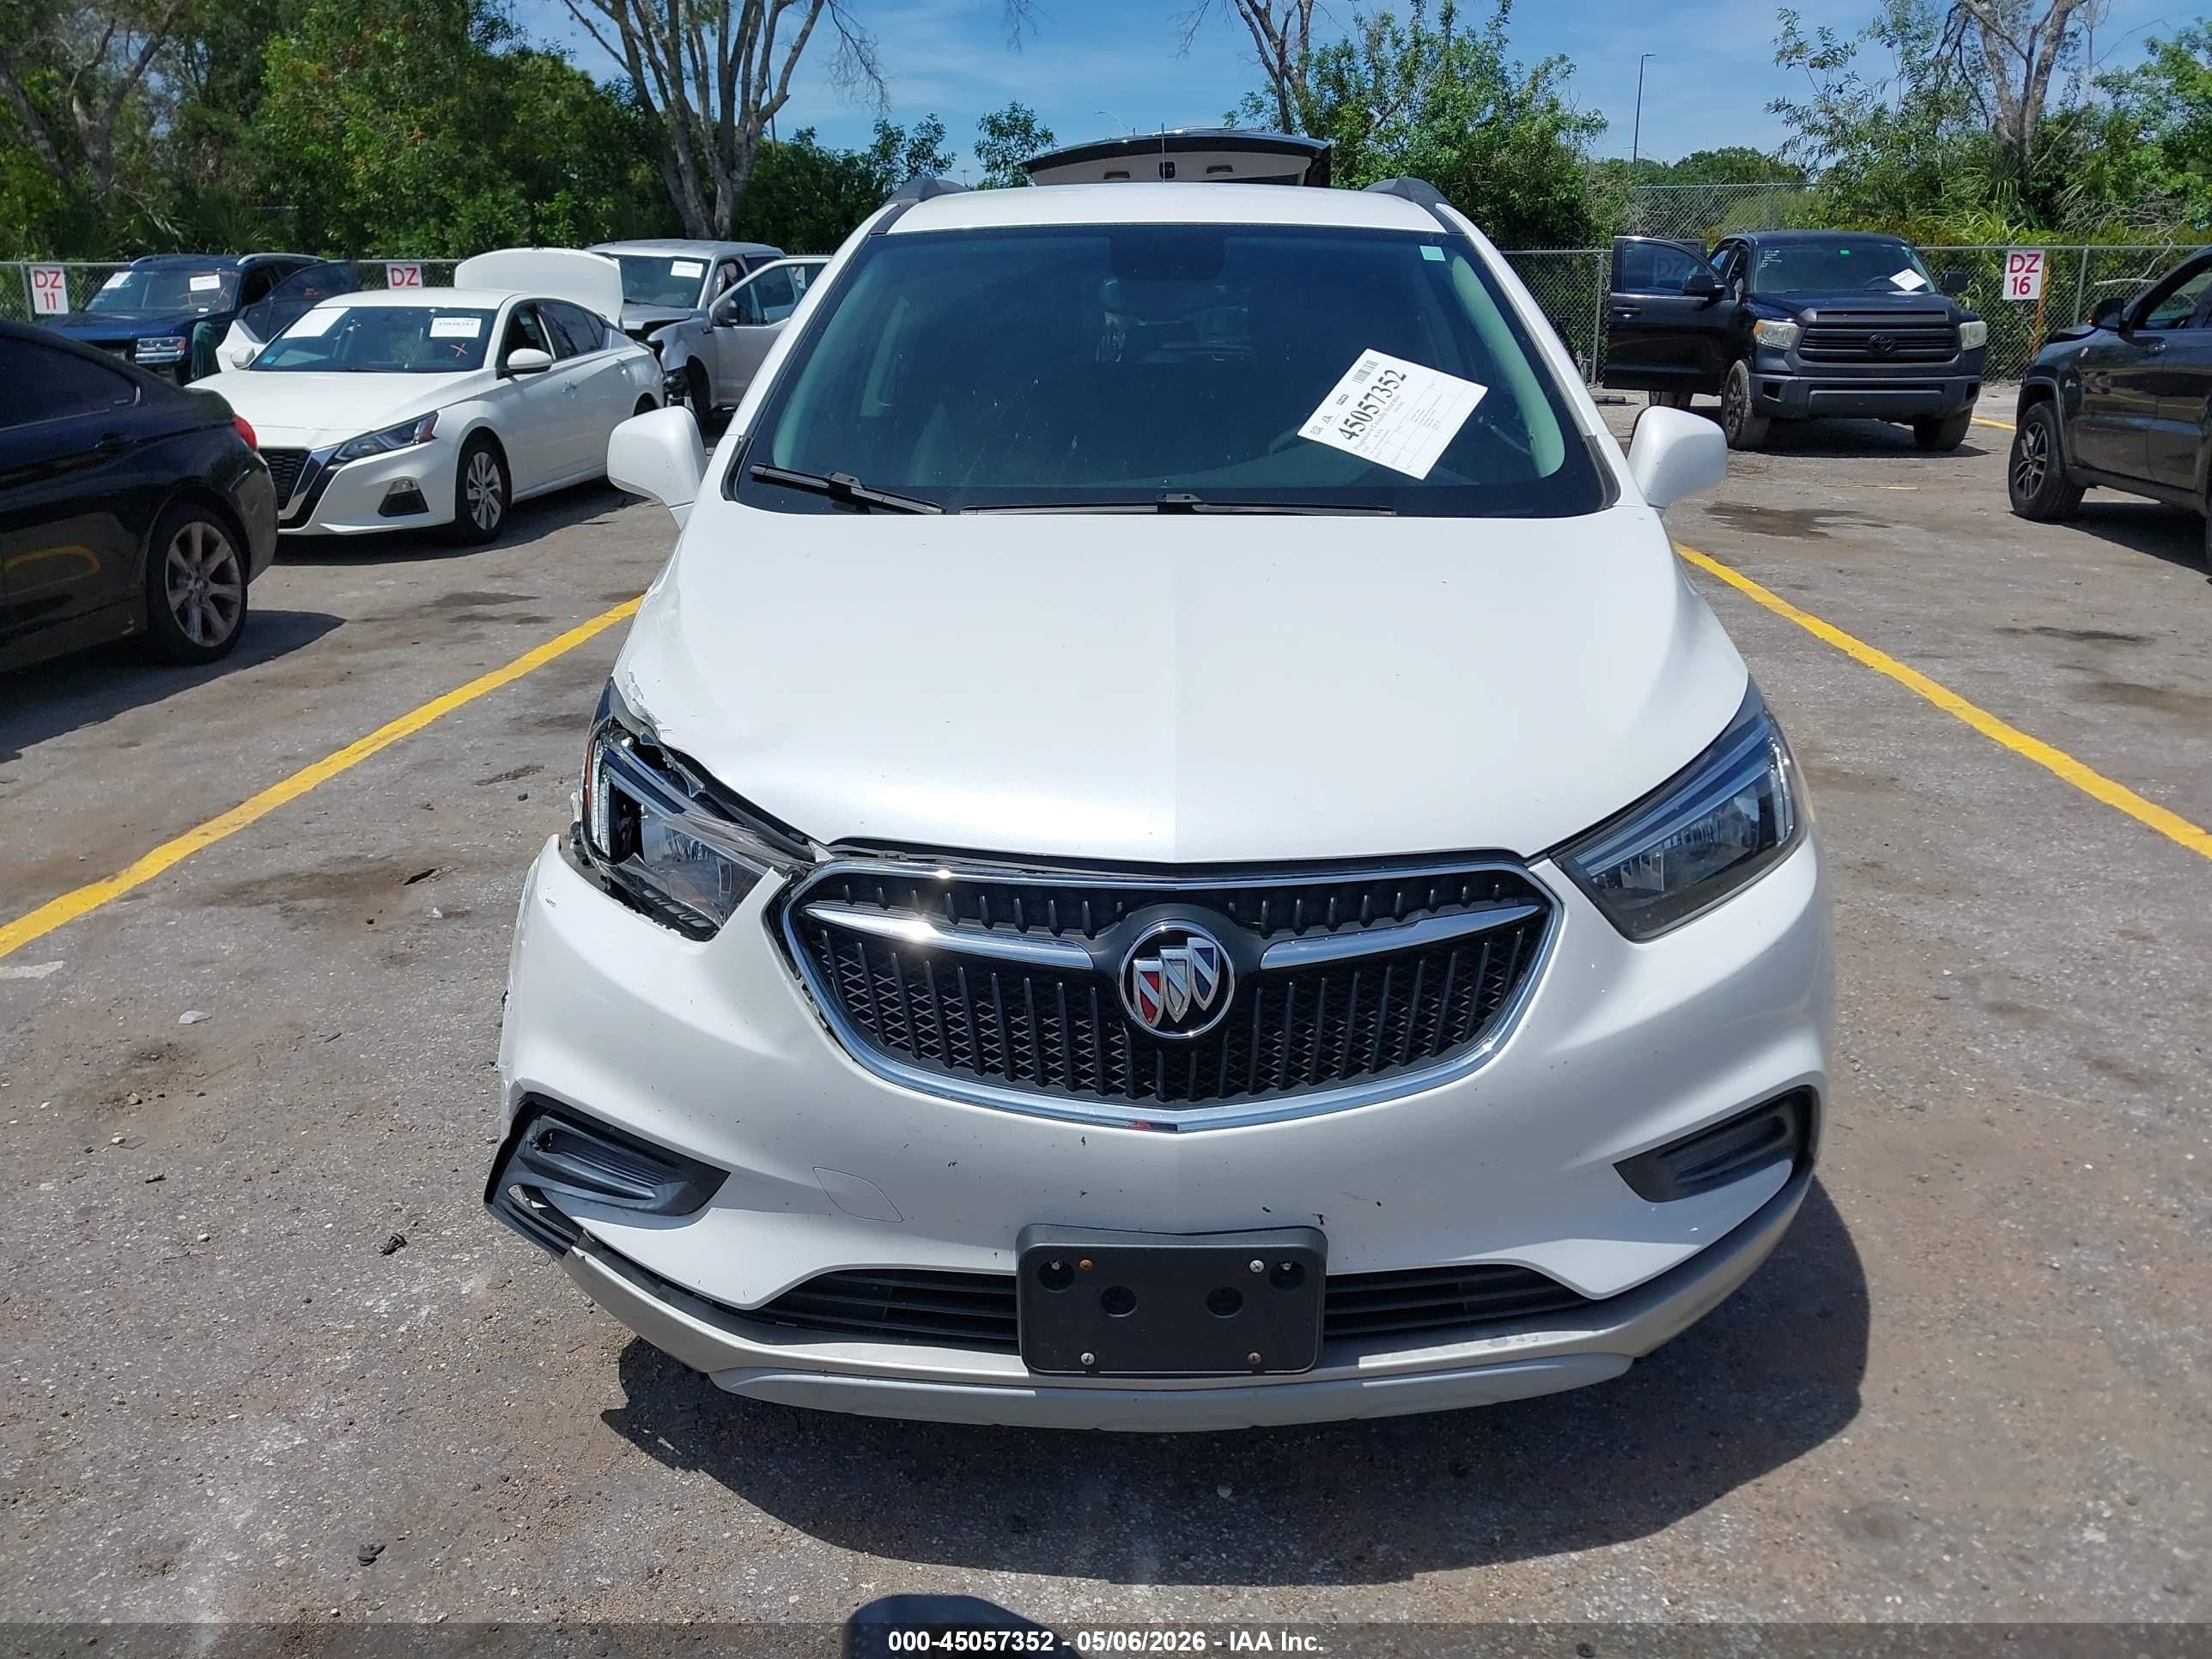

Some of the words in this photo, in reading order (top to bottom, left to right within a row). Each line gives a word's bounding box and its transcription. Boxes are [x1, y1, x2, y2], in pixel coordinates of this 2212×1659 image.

[2009, 253, 2041, 273] DZ
[33, 270, 63, 289] DZ
[391, 267, 419, 286] DZ
[2012, 276, 2031, 295] 16
[43, 291, 57, 310] 11
[1338, 369, 1407, 441] 45057352
